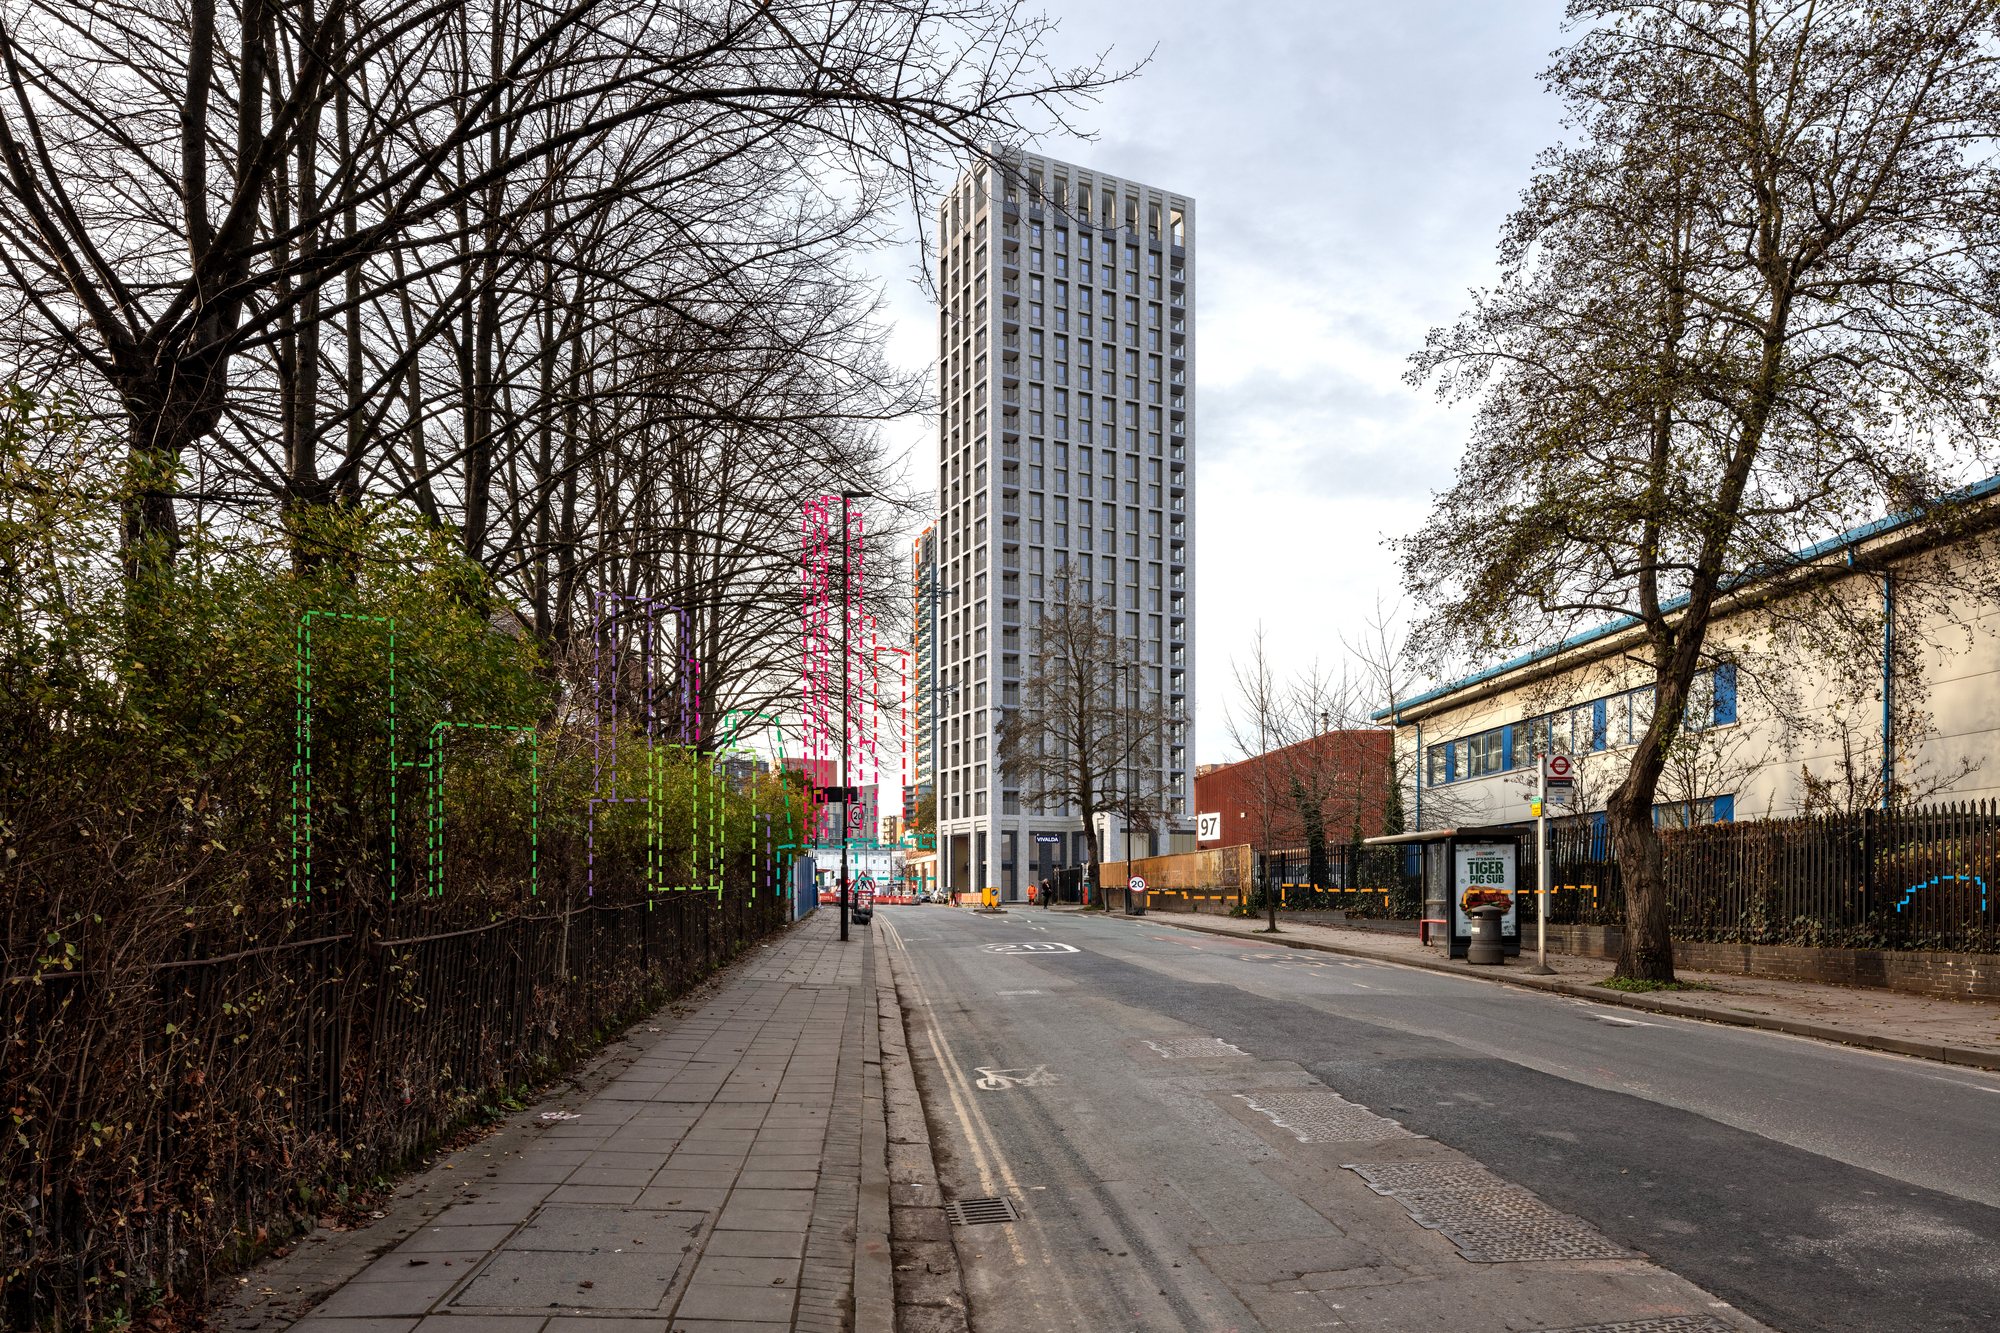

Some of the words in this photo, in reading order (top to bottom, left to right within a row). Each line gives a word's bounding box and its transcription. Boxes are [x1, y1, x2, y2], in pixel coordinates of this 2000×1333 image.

[1200, 817, 1217, 836] 97
[1467, 861, 1504, 874] TIGER
[1131, 880, 1144, 888] 20
[1470, 874, 1485, 884] PIG
[1486, 874, 1505, 884] SUB
